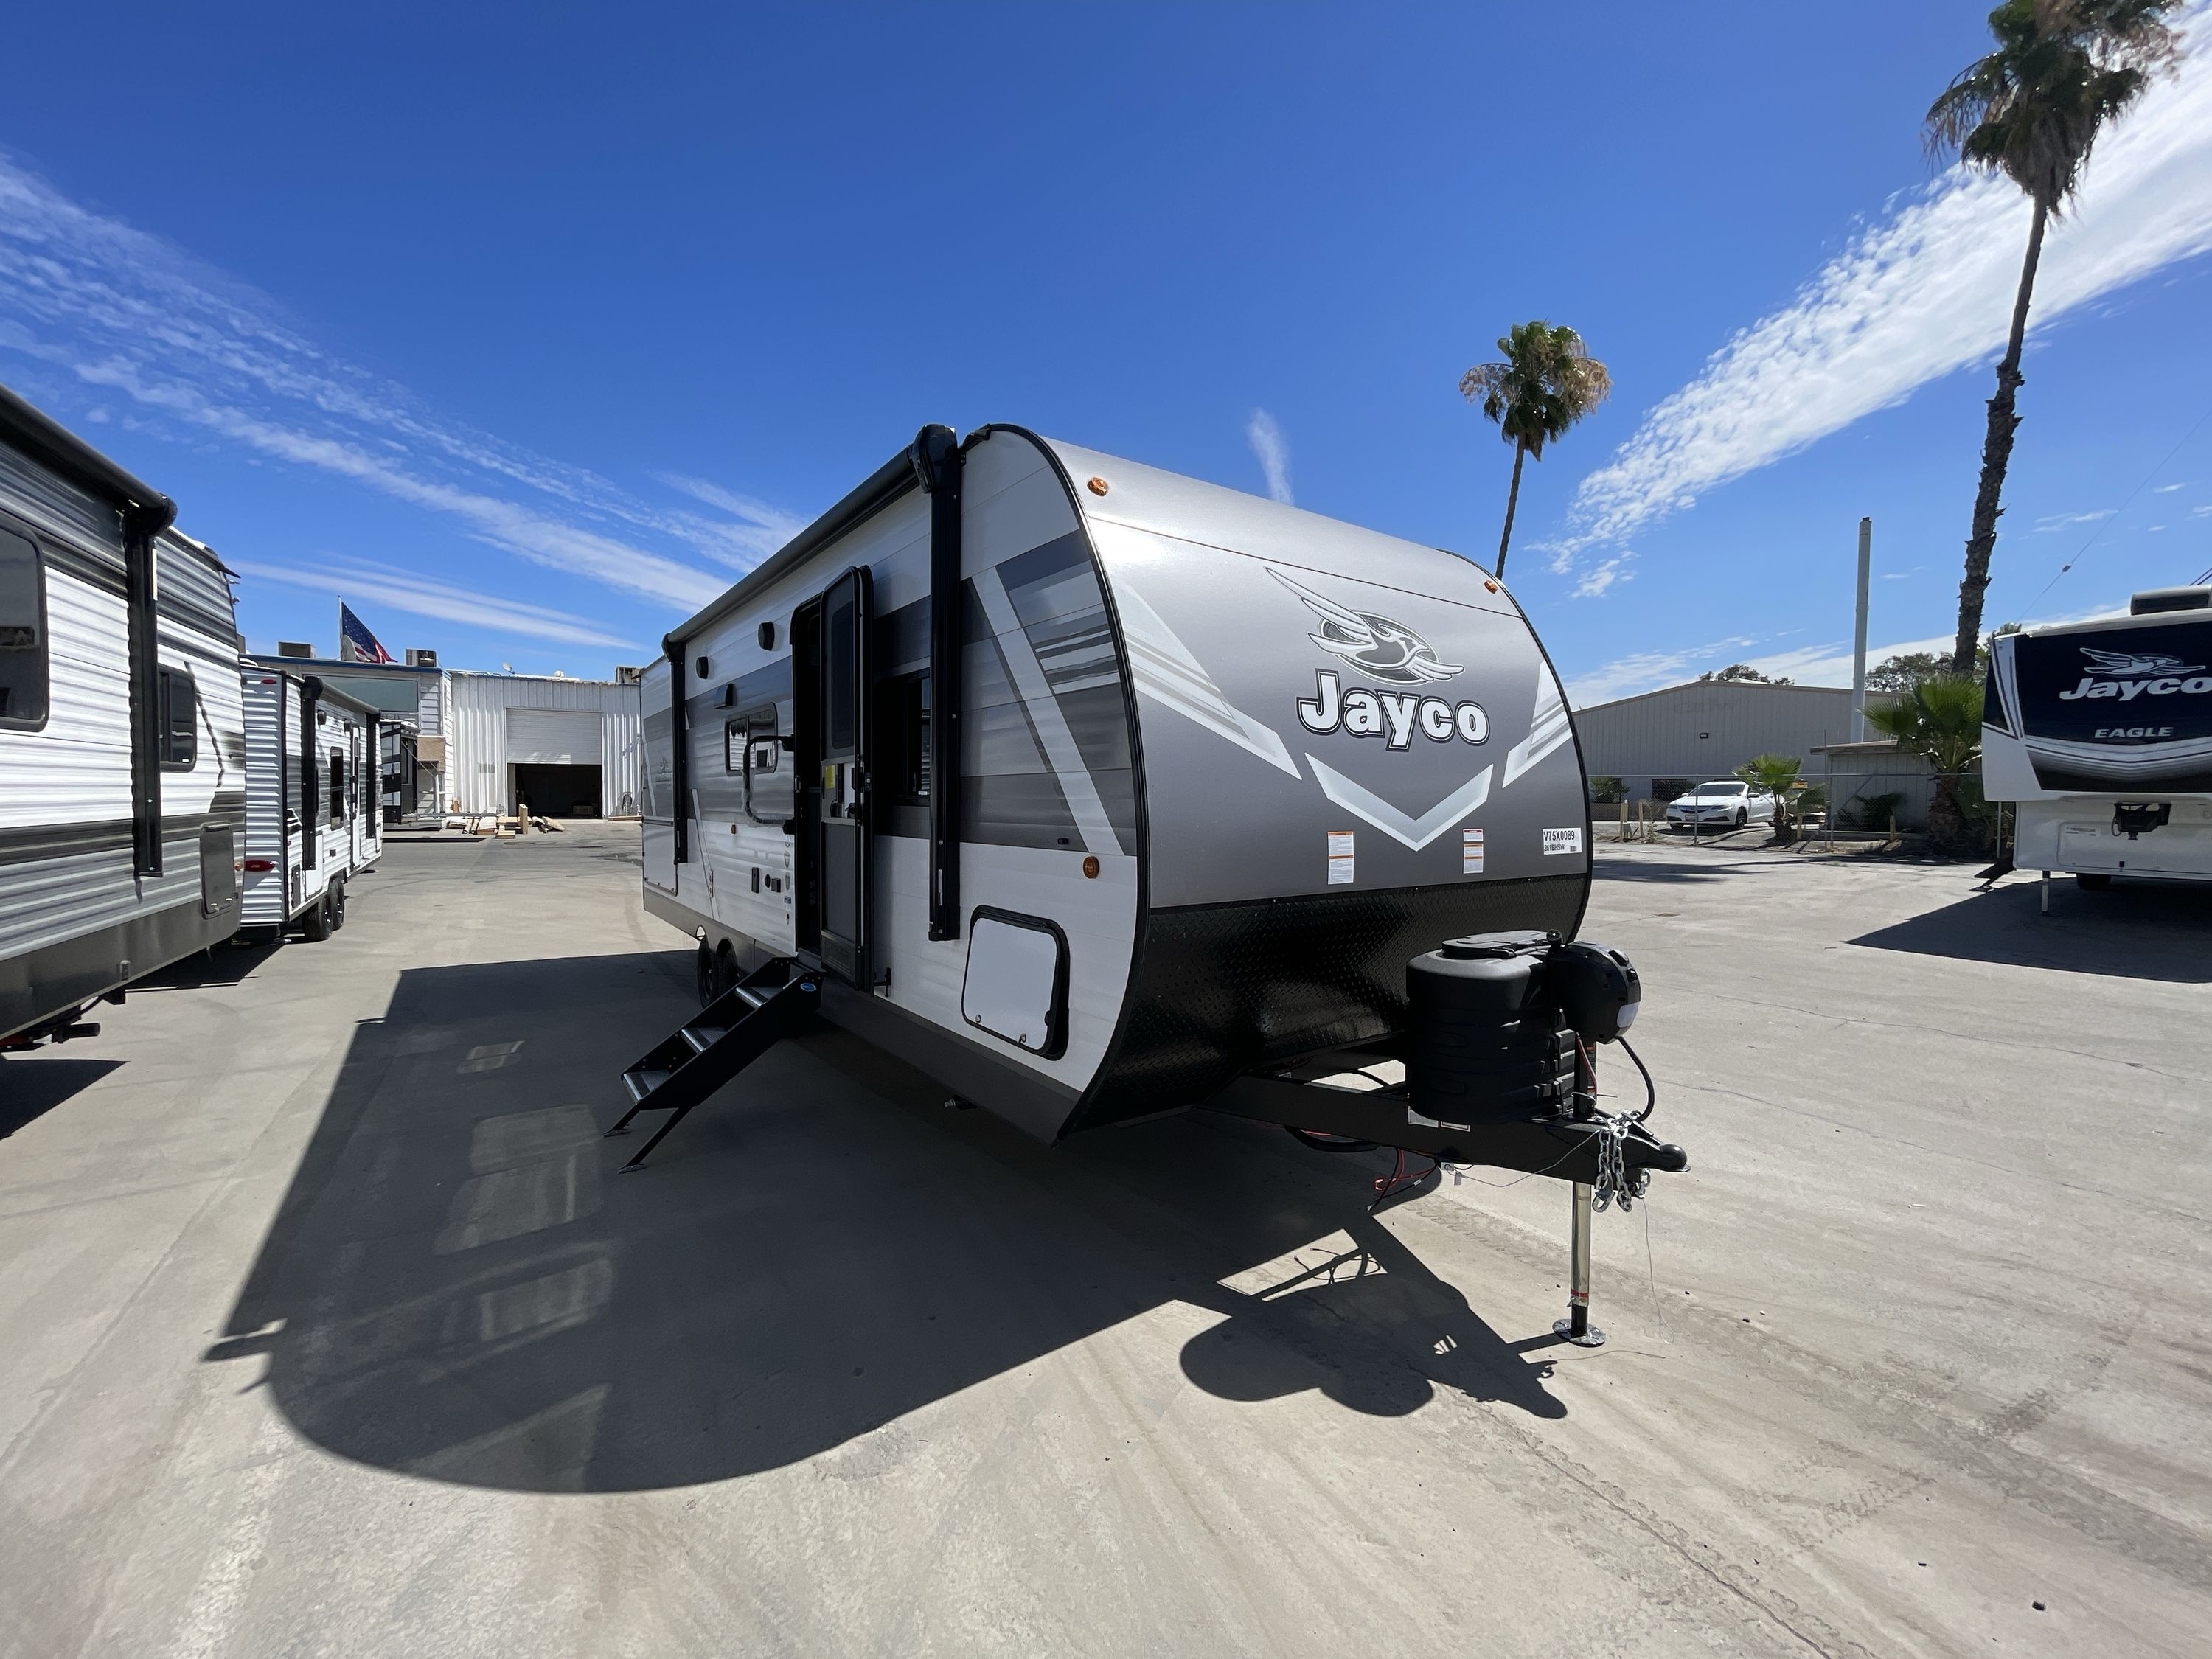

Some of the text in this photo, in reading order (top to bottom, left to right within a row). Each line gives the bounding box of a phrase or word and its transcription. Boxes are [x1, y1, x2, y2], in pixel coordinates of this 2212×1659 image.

[2059, 677, 2212, 701] Jayco
[1296, 668, 1490, 752] Jayco
[2095, 726, 2174, 738] EAGLE
